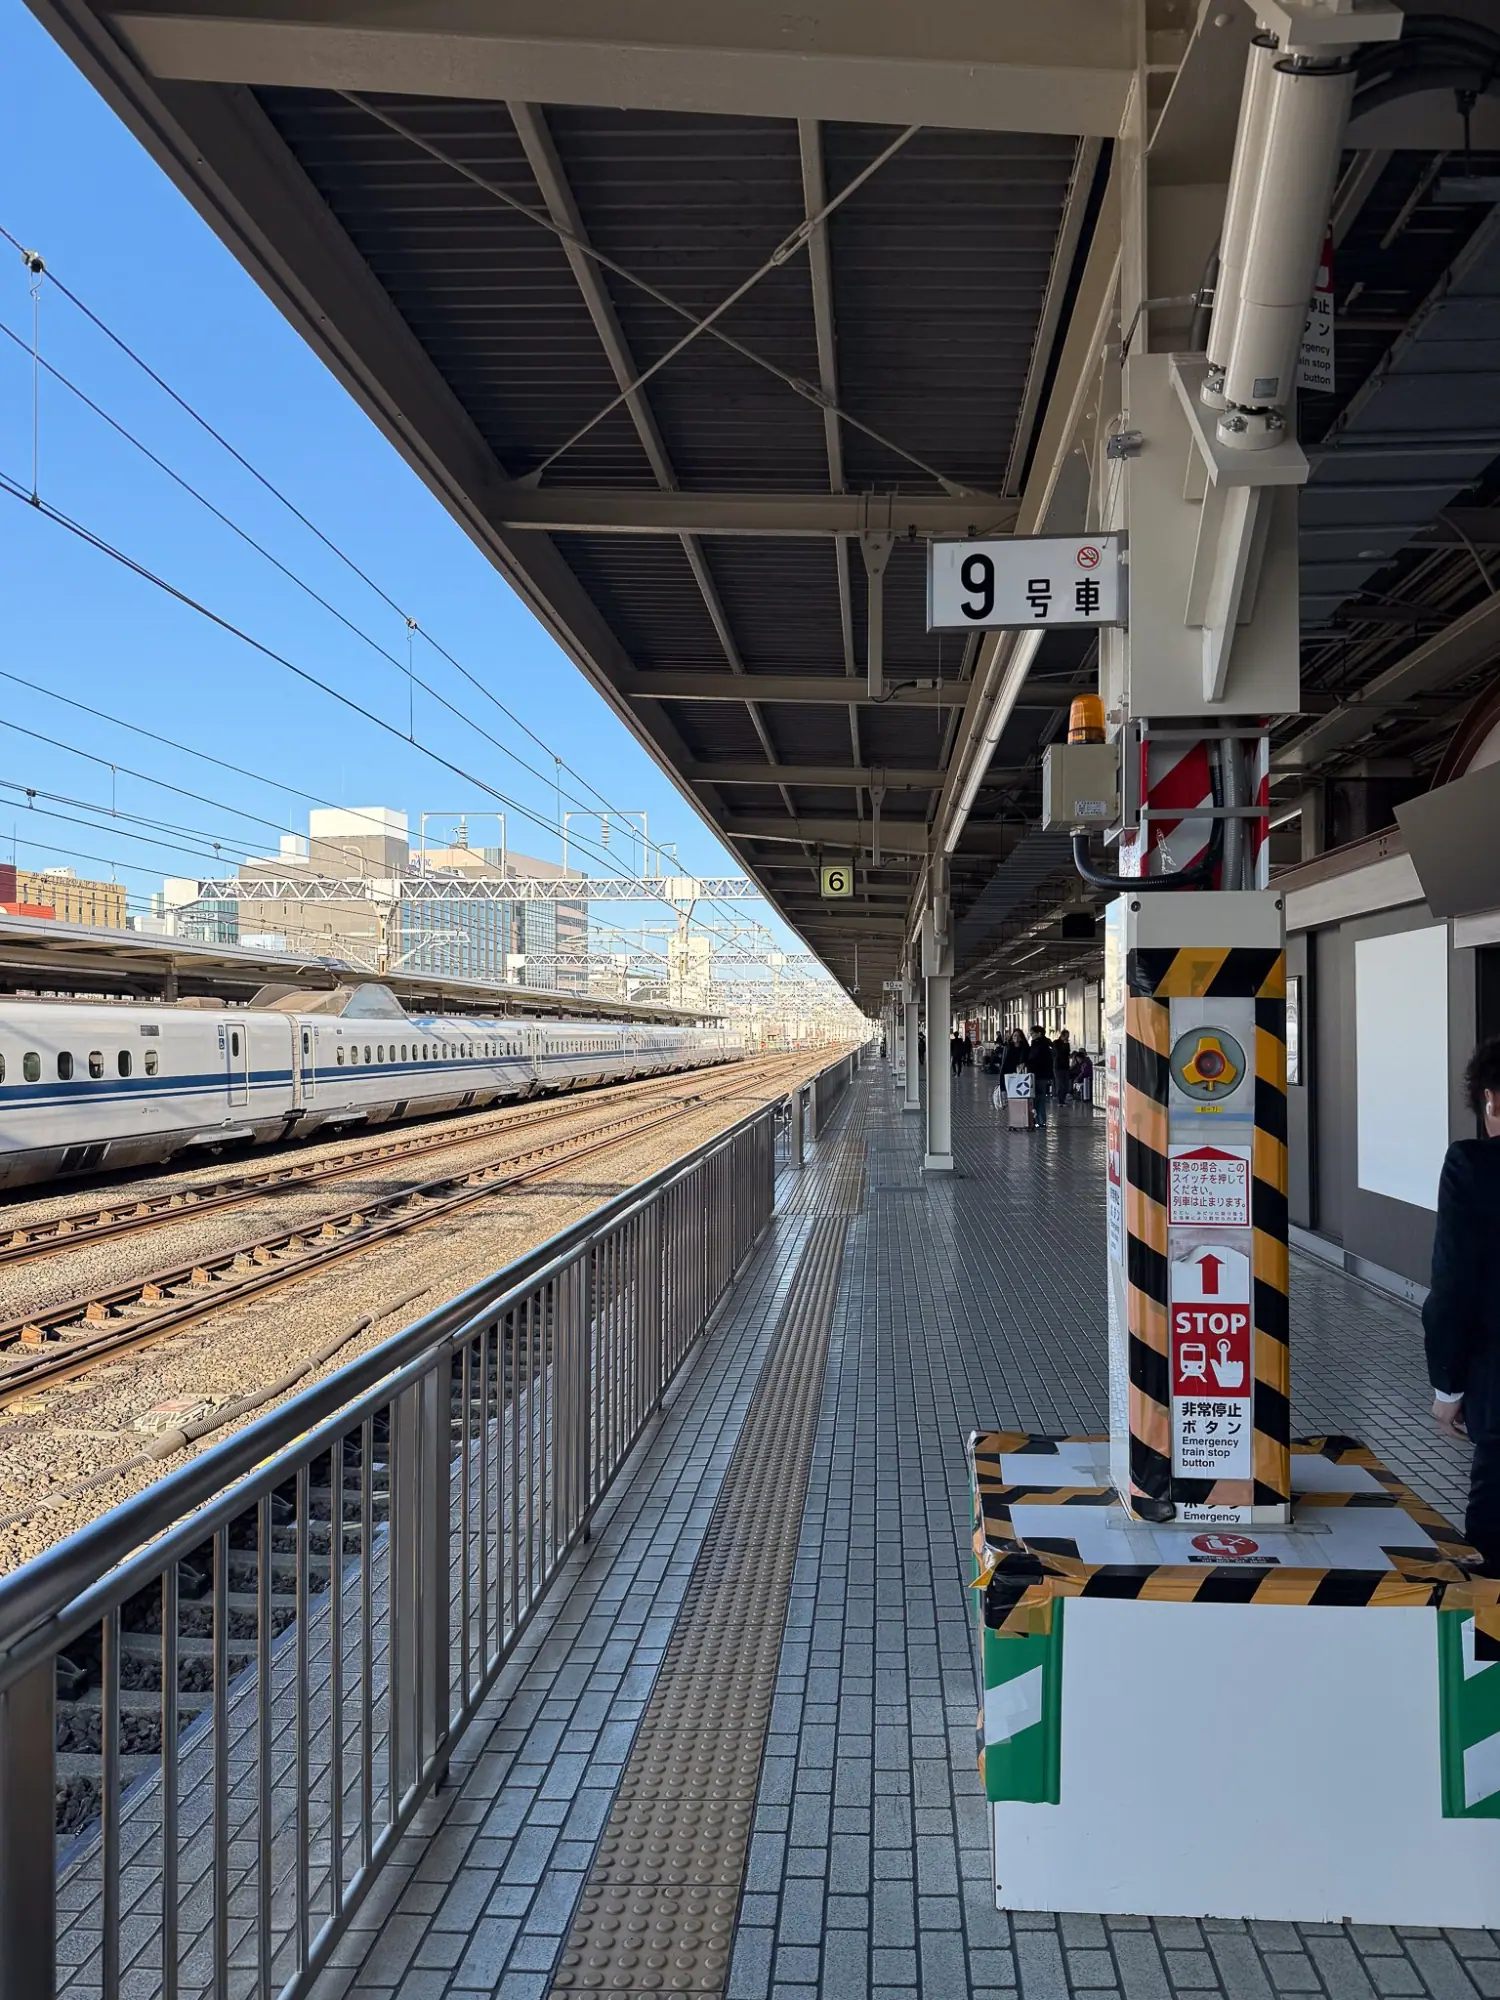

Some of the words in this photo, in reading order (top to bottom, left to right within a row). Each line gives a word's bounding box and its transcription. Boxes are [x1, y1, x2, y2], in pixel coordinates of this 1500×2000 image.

[1312, 359, 1331, 372] stop
[1304, 372, 1331, 385] button
[828, 871, 845, 892] 6
[1172, 1161, 1246, 1173] 緊急の場合、この
[1172, 1174, 1245, 1185] スイッチを押して
[1172, 1184, 1213, 1196] ください。
[1172, 1196, 1246, 1208] 列車は止まります。
[1175, 1311, 1247, 1335] STOP
[1181, 1402, 1243, 1418] 非常停止
[1182, 1420, 1242, 1435] ボタン
[1181, 1436, 1239, 1448] Emergency
[1181, 1448, 1205, 1457] train
[1207, 1449, 1231, 1459] stop
[1182, 1458, 1215, 1468] button
[1183, 1511, 1241, 1523] Emergency
